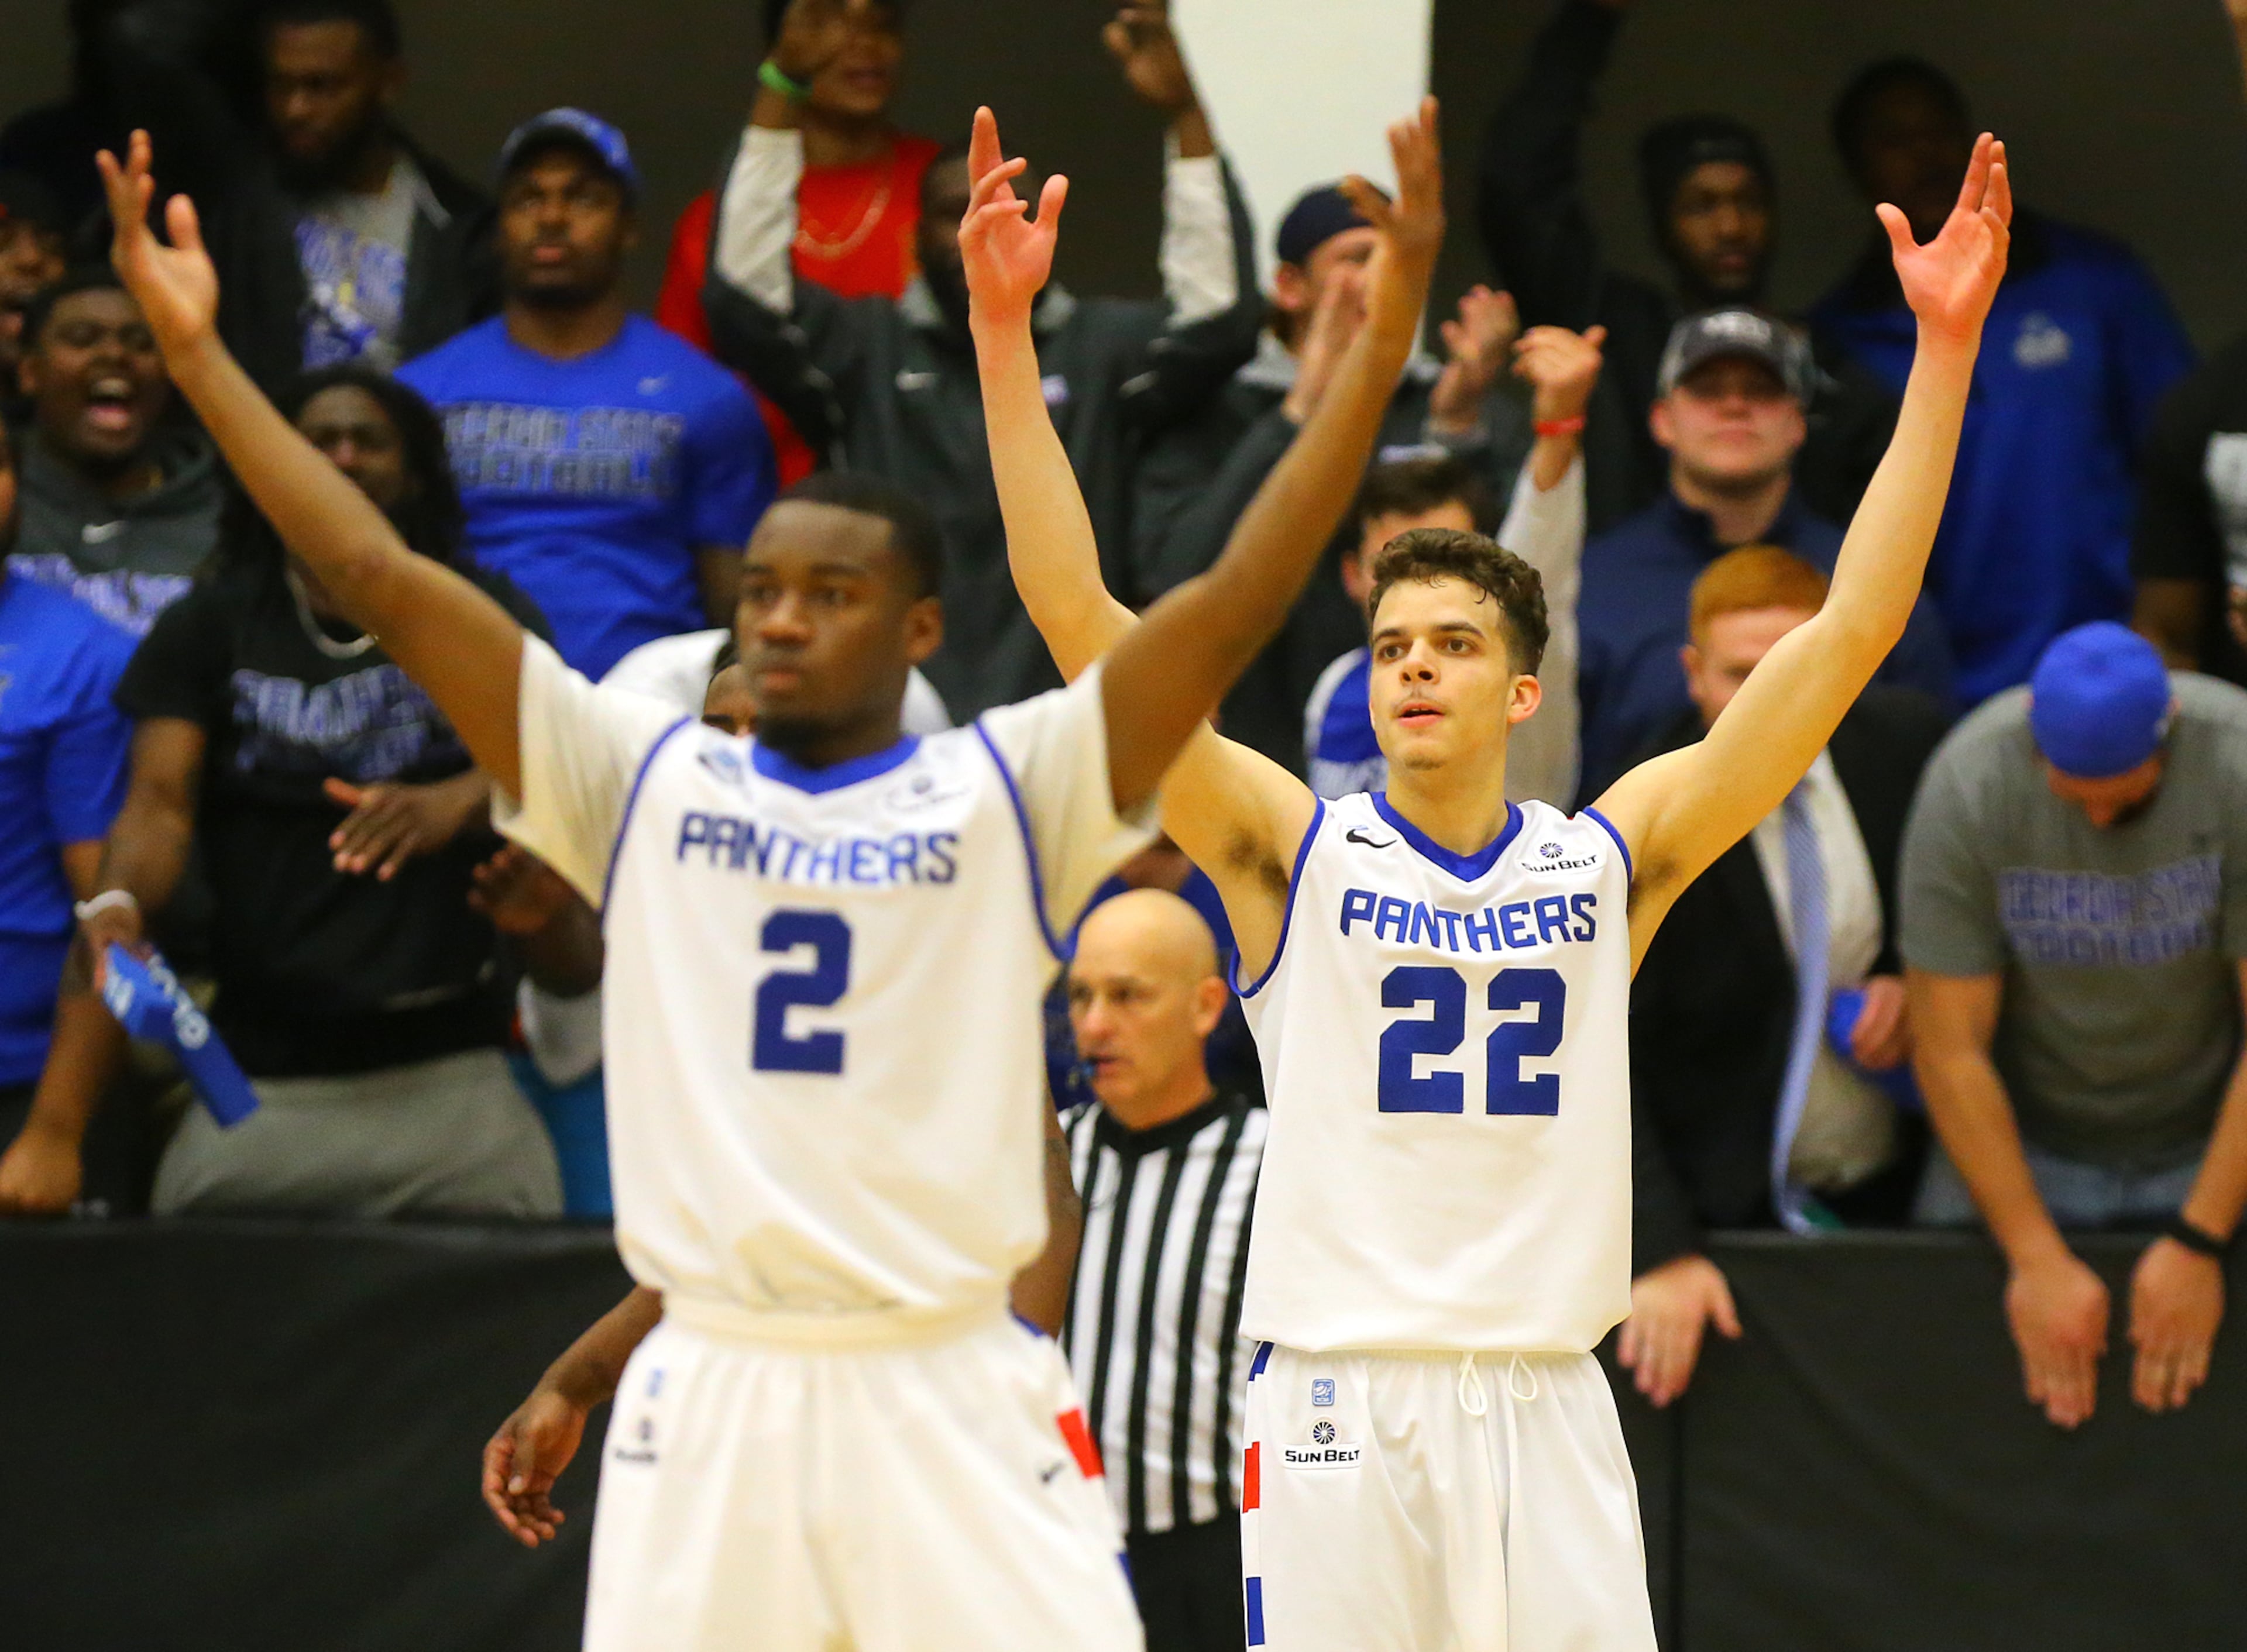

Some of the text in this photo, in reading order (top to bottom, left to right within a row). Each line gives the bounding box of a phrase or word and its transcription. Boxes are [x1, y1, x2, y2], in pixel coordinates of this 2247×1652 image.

[676, 810, 960, 887] PANTHERS
[1558, 855, 1597, 870] BELT
[1340, 888, 1597, 952] PANTHERS
[751, 907, 851, 1075] 2
[1377, 965, 1567, 1116] 22
[1285, 1449, 1360, 1462] SUN BELT
